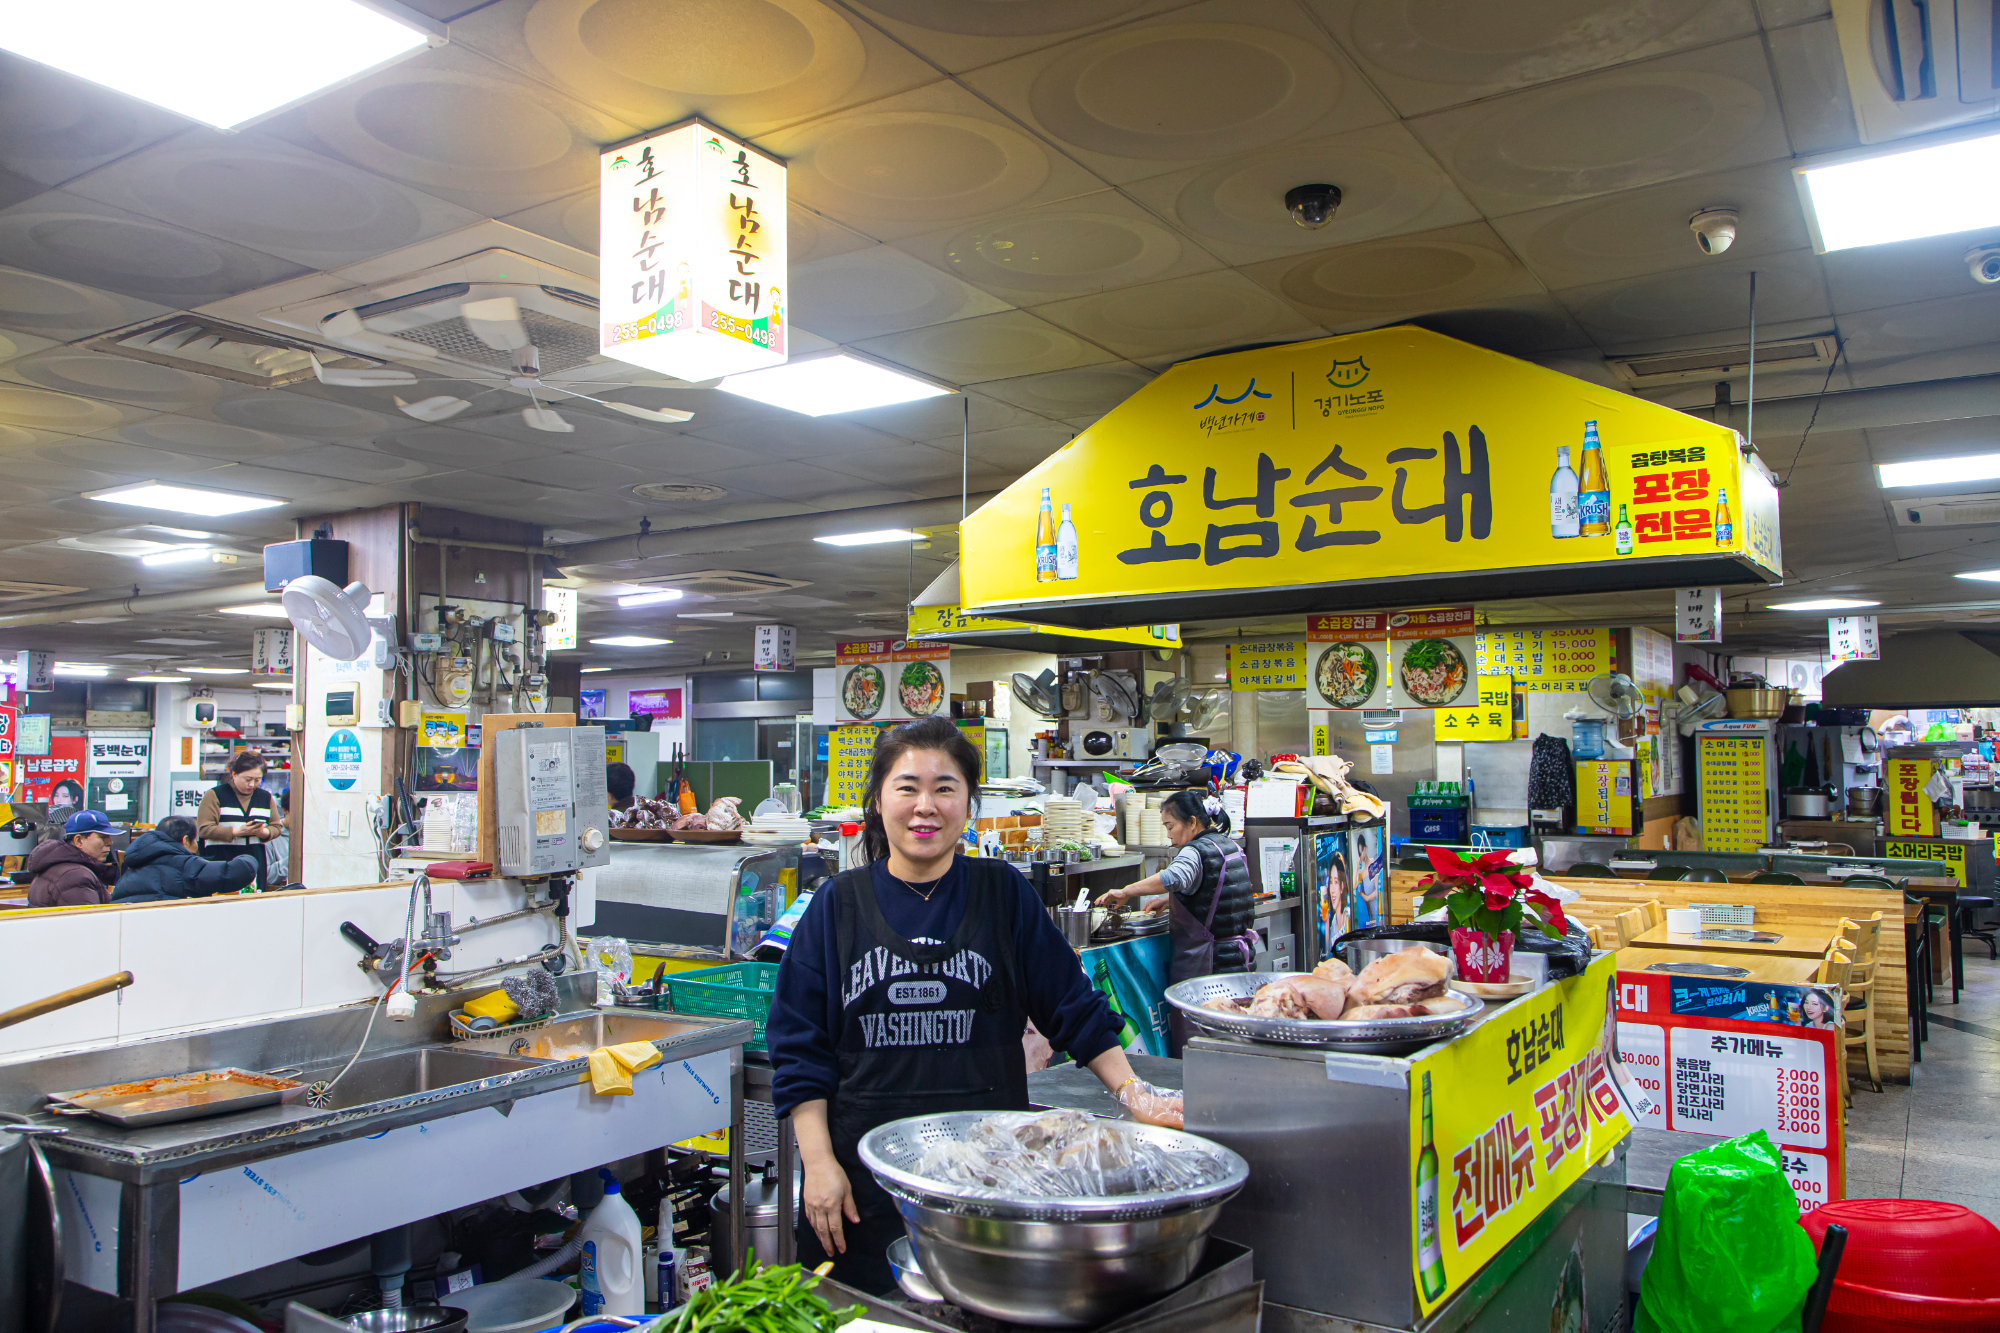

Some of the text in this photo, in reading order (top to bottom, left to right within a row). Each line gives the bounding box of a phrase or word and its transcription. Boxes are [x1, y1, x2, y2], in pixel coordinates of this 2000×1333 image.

[632, 146, 666, 305] 호남순대
[728, 150, 761, 316] 호남순대
[613, 310, 684, 343] 255-0498
[711, 310, 776, 348] 255-0498
[1314, 389, 1385, 417] 경기노포
[1338, 406, 1367, 416] GYEONGGI
[1368, 404, 1385, 413] NOPO
[1200, 410, 1256, 439] 백년가게
[1116, 424, 1493, 566] 호남순대
[1632, 468, 1711, 505] 포장
[1580, 503, 1609, 520] KRUSH
[1634, 508, 1713, 544] 전문
[1317, 616, 1377, 630] 소곱창전골
[843, 641, 885, 655] 소곱창전골
[1239, 641, 1295, 654] 순대곱창볶음
[1476, 639, 1596, 653] 머리고기 15,000
[1239, 657, 1296, 669] 소곱창볶음
[1476, 651, 1595, 664] 순대국밥 10,000
[1239, 673, 1296, 685] 야채닭갈비
[1477, 664, 1596, 675] 소곱창전골 18,000
[1529, 682, 1588, 692] 소머리국밥
[1480, 690, 1510, 707] 국밥
[424, 720, 459, 737] 콩국수
[1444, 712, 1503, 728] 소수육
[838, 727, 878, 736] 소머리국밥
[838, 736, 877, 746] 백순대볶
[92, 744, 148, 757] 동백순대
[1704, 740, 1761, 749] 소머리국밥
[26, 758, 79, 773] 남문곱창
[1596, 762, 1611, 827] 포장됩니다
[1899, 763, 1922, 832] 포장됩니다
[1424, 825, 1441, 833] Cass
[1888, 842, 1963, 861] 소머리국밥
[1615, 983, 1649, 1013] 대
[1746, 1003, 1770, 1017] KRUSH
[1507, 1003, 1566, 1086] 호남순대
[1710, 1035, 1784, 1059] 추가메뉴
[1676, 1057, 1819, 1083] 볶음밥 2,000
[1676, 1069, 1820, 1096] 라면사리 2,000
[1676, 1082, 1820, 1109] 당면사리 2,000
[1677, 1094, 1820, 1122] 치즈사리 3,000
[1677, 1108, 1821, 1135] 떡사리 2,000
[1451, 1048, 1621, 1252] 전메뉴 포장가능
[243, 1166, 264, 1186] STEEL
